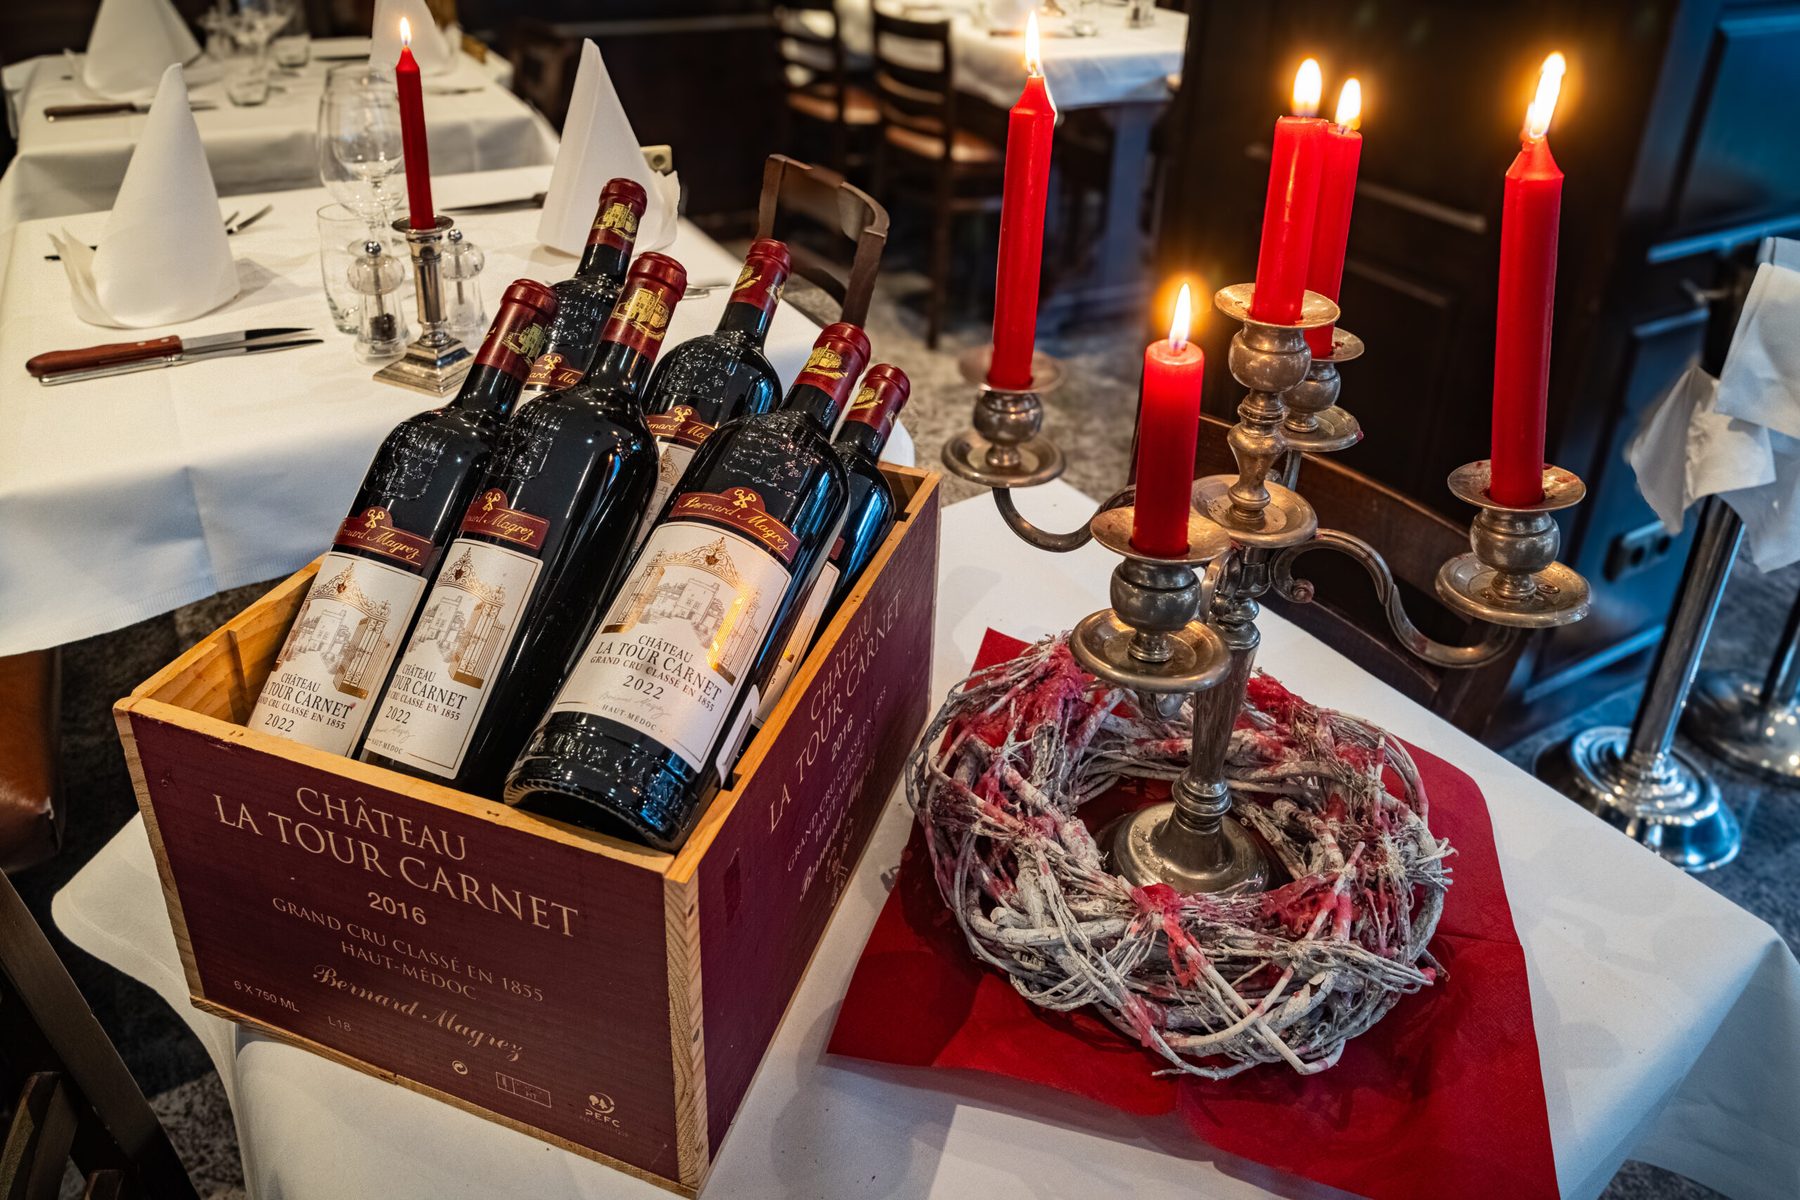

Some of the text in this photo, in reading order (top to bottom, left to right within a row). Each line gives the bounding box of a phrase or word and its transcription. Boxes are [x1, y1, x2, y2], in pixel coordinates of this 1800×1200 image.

[483, 513, 535, 542] Magrez
[737, 508, 790, 550] Magrez
[367, 530, 420, 560] Magrez
[638, 634, 694, 663] CHÂTEAU
[590, 655, 621, 665] GRAND
[623, 659, 643, 671] CRU
[682, 685, 697, 697] EN
[697, 695, 715, 712] 1855
[595, 641, 722, 700] LA TOUR CARNET
[622, 674, 664, 700] 2022
[267, 681, 294, 701] TOUR
[294, 690, 352, 720] CARNET
[411, 680, 467, 710] CARNET
[426, 702, 439, 713] EN
[440, 708, 461, 721] 1855
[769, 588, 901, 834] LA TOUR CARNET
[264, 713, 295, 733] 2022
[311, 712, 325, 722] EN
[326, 717, 346, 730] 1855
[385, 705, 411, 725] 2022
[831, 714, 854, 762] 2016
[296, 787, 467, 861] CHÂTEAU
[212, 793, 579, 937] LA TOUR CARNET
[367, 891, 427, 925] 2016
[272, 897, 545, 1002] GRAND CRU CLASSÉ EN 1855
[341, 940, 477, 1000] HAUT-MÉDOC
[255, 986, 278, 1004] 750
[279, 996, 300, 1013] ML
[312, 963, 524, 1062] Bernard Magrez
[585, 1108, 621, 1128] PEFC
